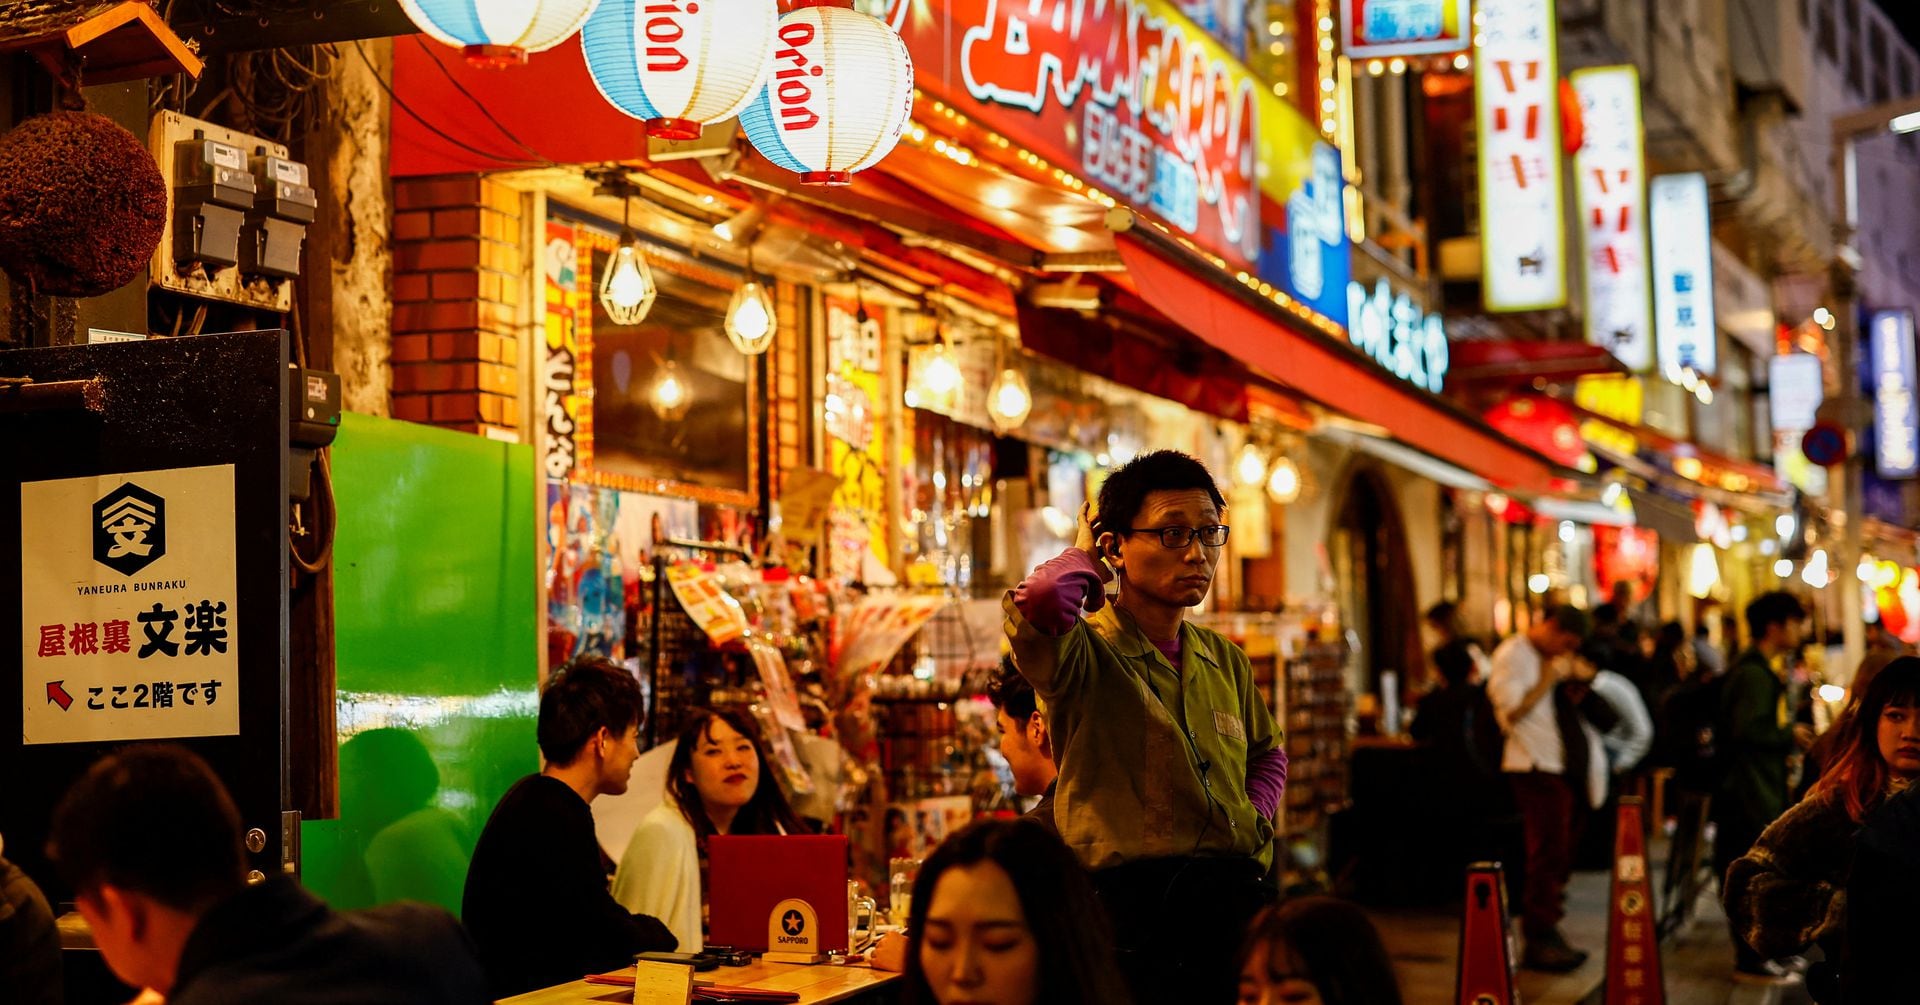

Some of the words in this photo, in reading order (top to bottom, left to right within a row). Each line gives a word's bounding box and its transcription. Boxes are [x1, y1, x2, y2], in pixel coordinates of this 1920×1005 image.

[645, 0, 699, 71] ion
[77, 584, 127, 596] YANEURA
[134, 579, 187, 592] BUNRAKU
[86, 679, 223, 710] ここ2階です
[778, 936, 809, 945] SAPPORO
